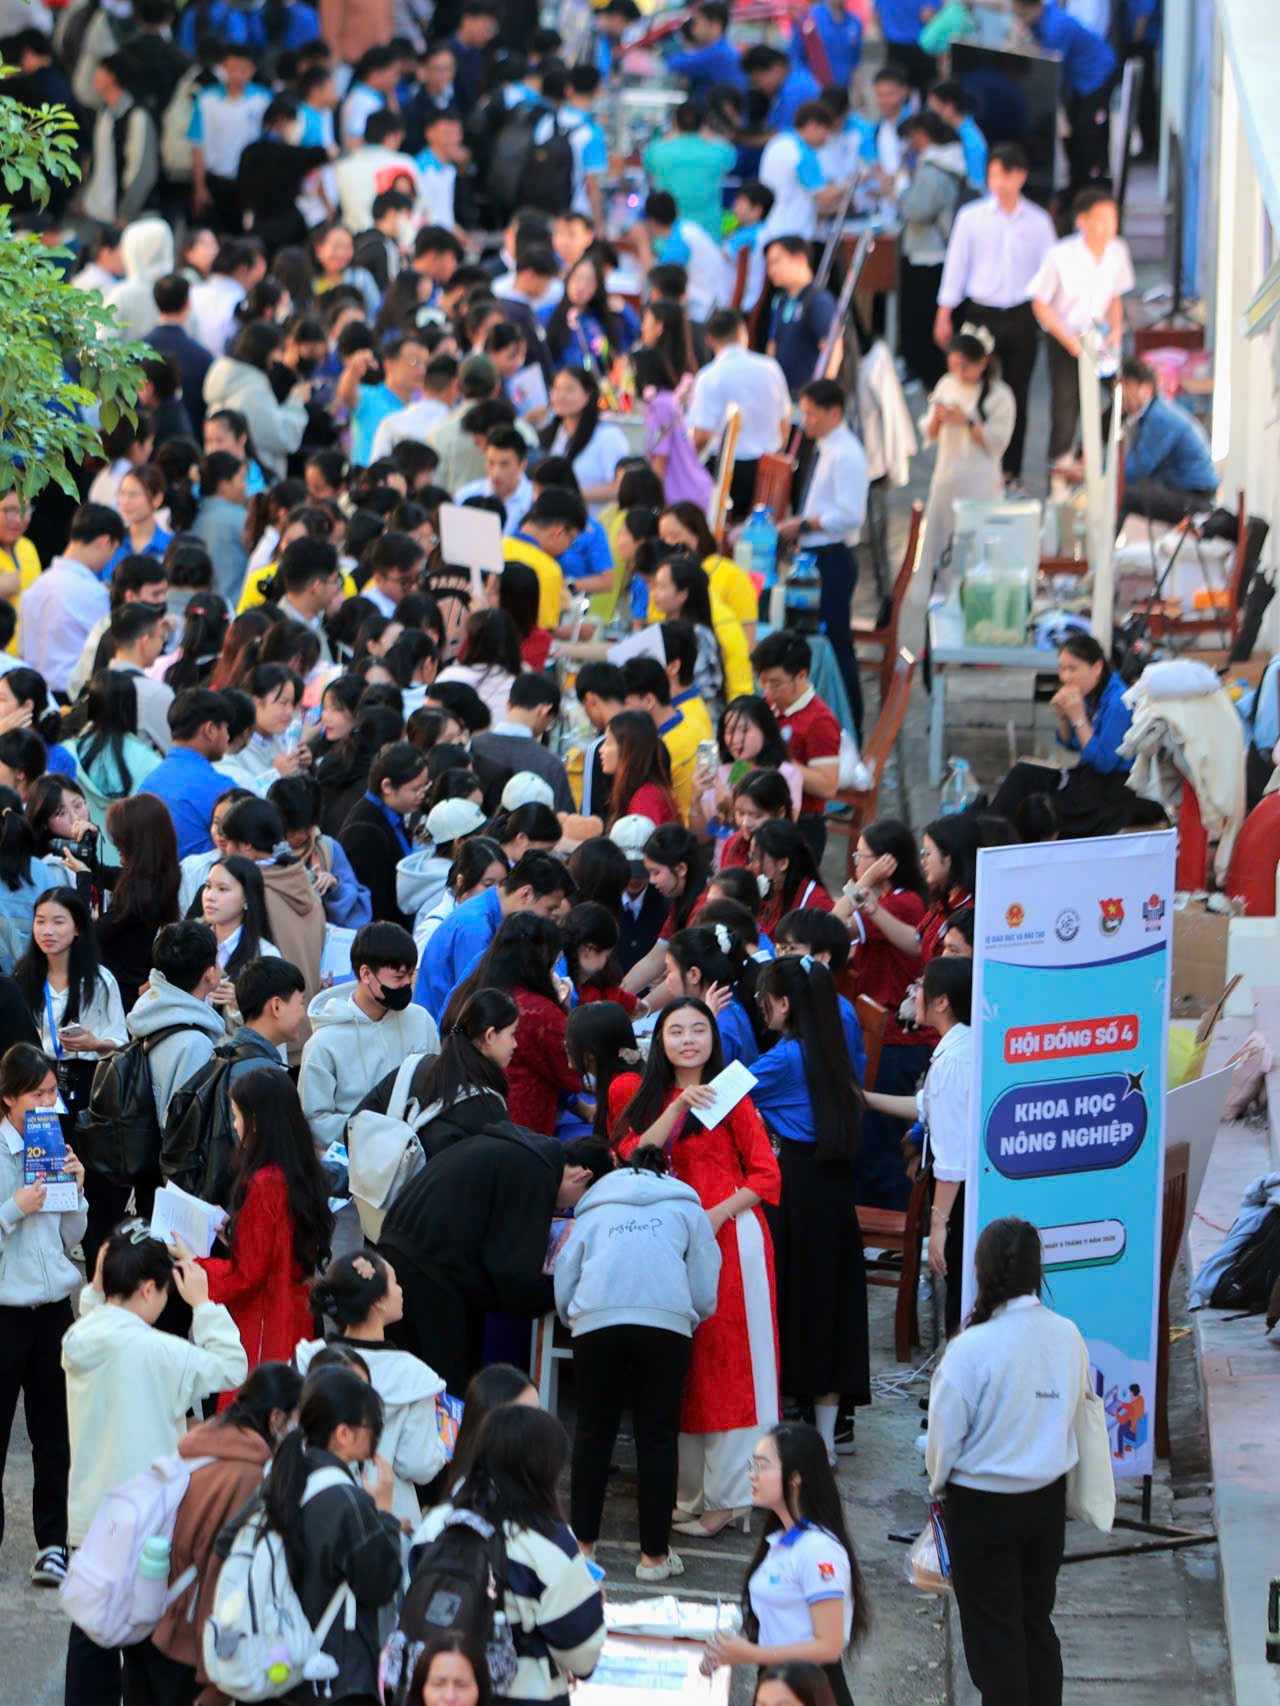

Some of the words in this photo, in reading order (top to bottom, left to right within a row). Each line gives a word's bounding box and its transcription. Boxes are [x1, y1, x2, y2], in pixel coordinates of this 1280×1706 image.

[1009, 1031, 1039, 1056] HỘI
[1095, 1021, 1120, 1046] SỐ
[1121, 1024, 1133, 1041] 4
[1014, 1098, 1070, 1123] KHOA
[1074, 1093, 1116, 1117] HỌC
[1000, 1130, 1056, 1156] NÔNG
[1061, 1120, 1134, 1148] NGHIỆP
